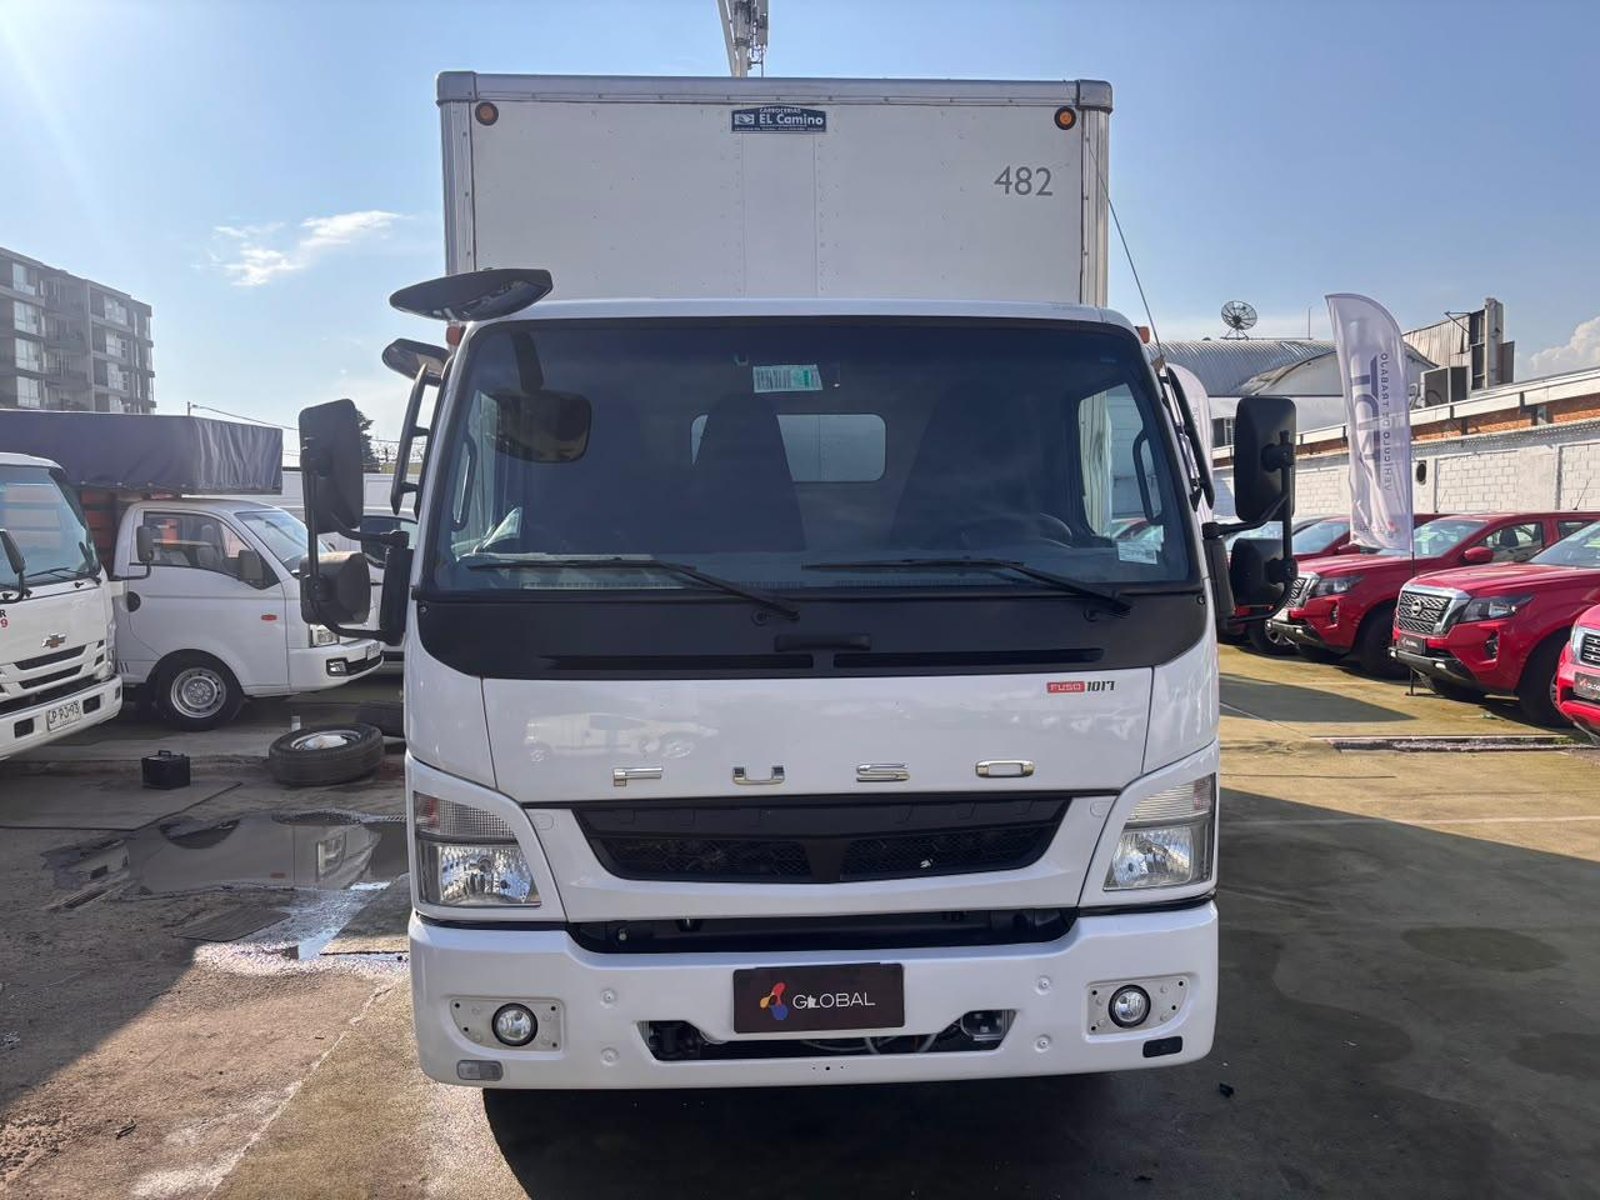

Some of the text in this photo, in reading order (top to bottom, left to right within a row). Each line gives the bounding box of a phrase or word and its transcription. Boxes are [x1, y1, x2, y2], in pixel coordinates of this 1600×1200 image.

[759, 113, 824, 125] EL Camino
[994, 165, 1053, 196] 482
[1087, 680, 1116, 691] 1017
[613, 760, 1035, 787] FUSO
[792, 991, 876, 1010] GLOBAL
